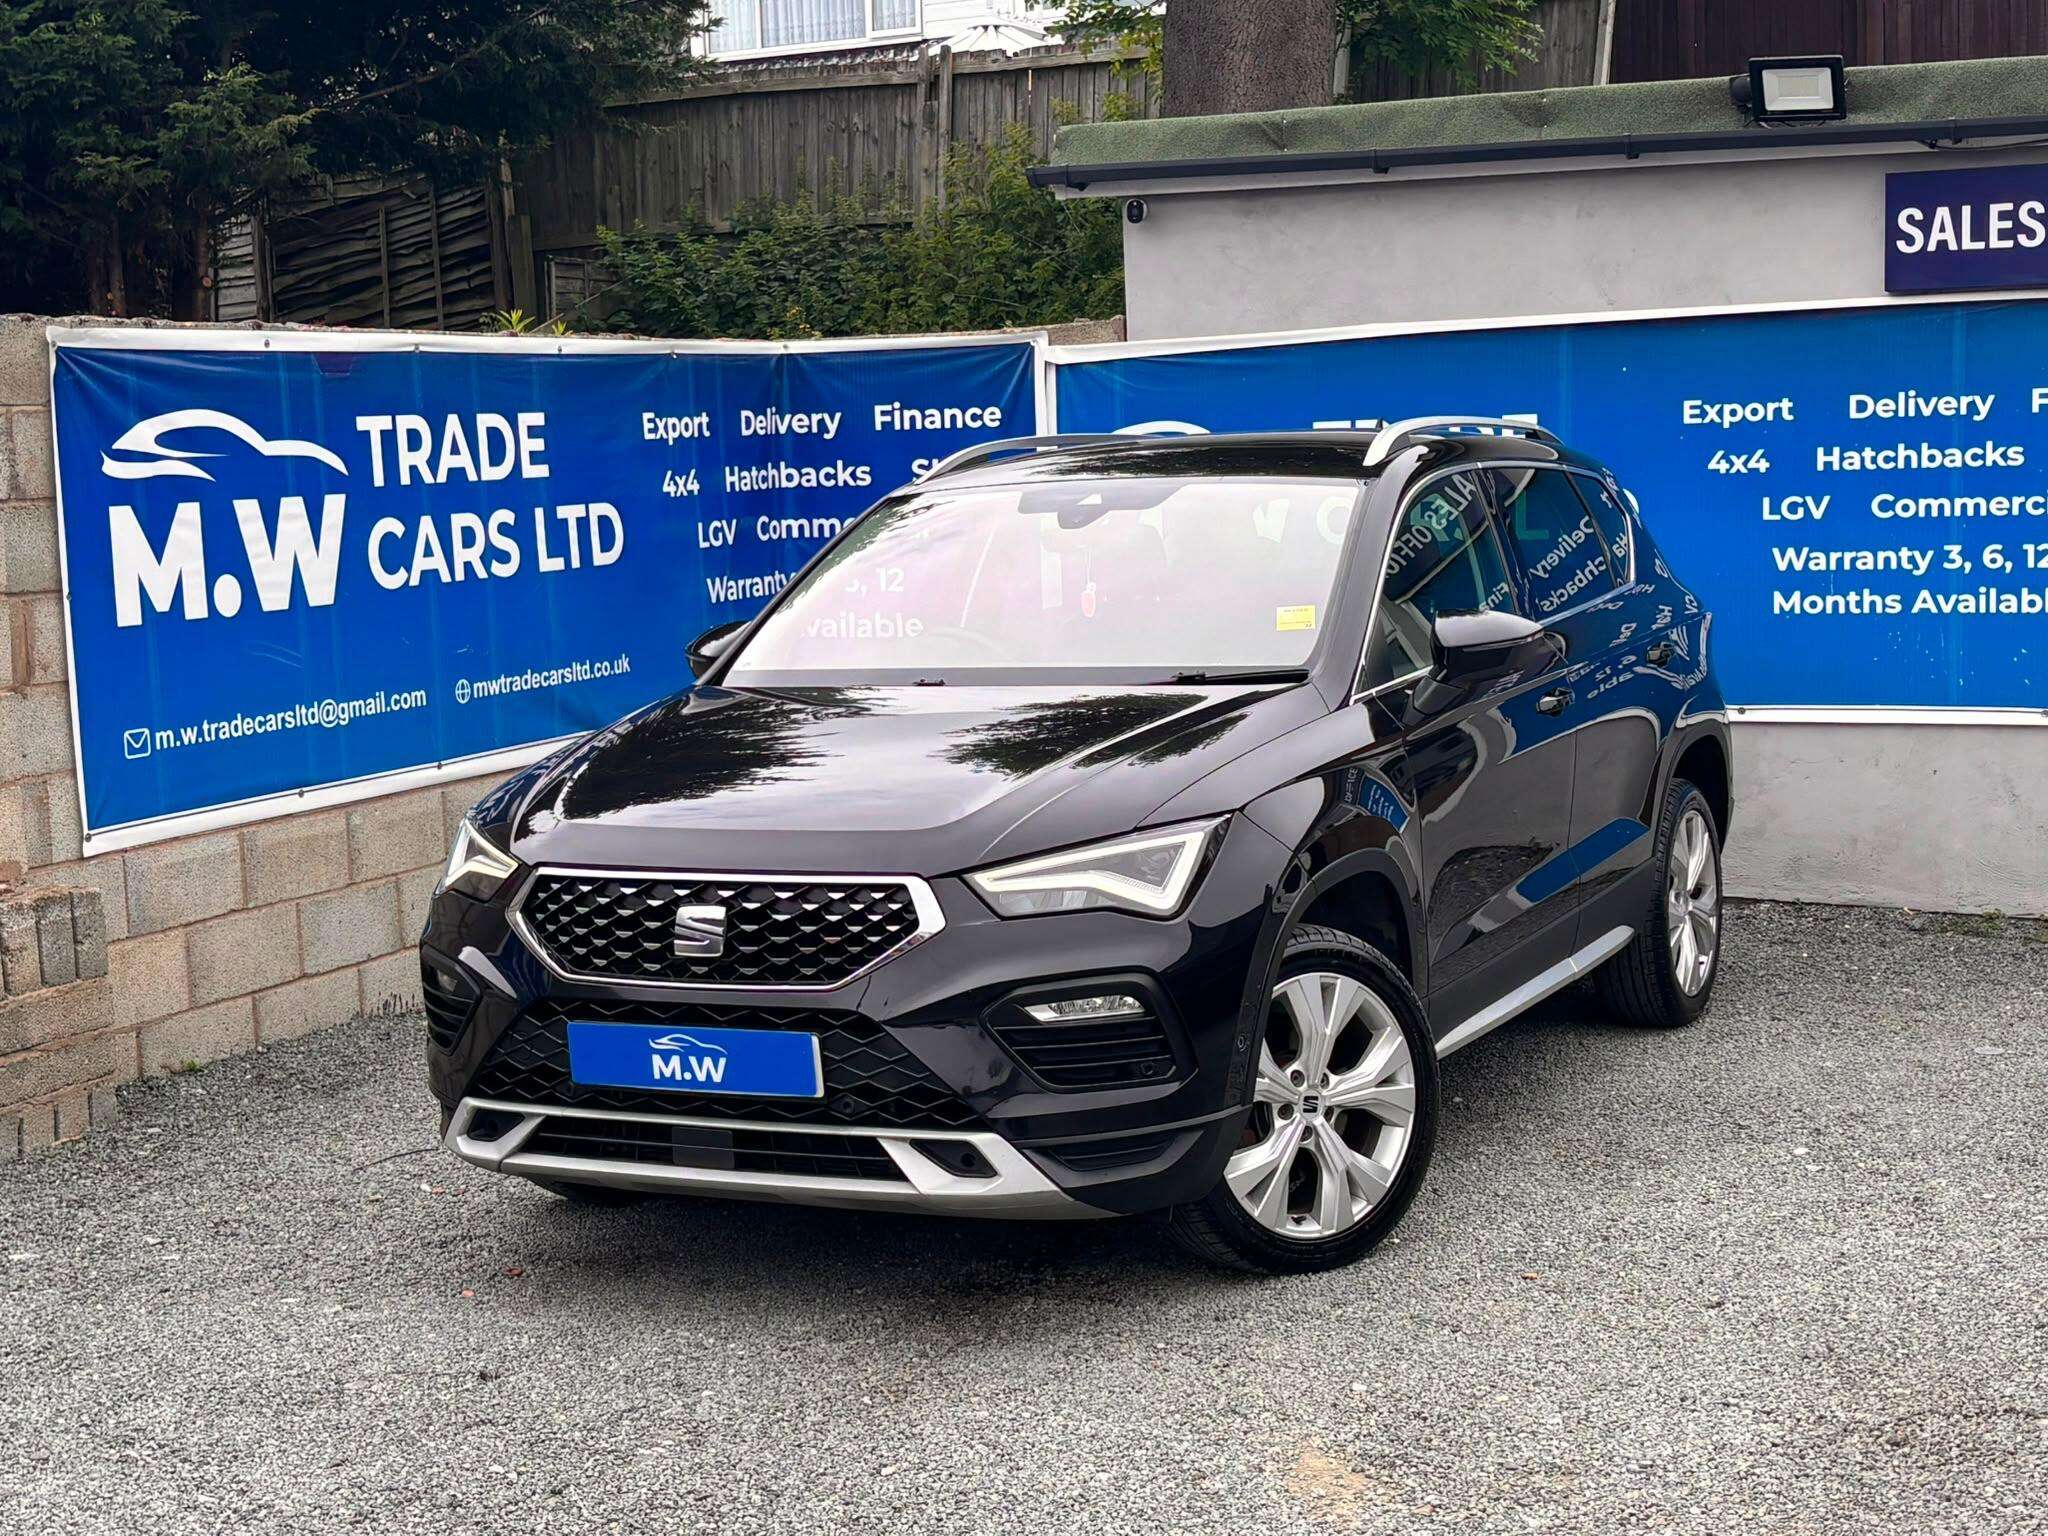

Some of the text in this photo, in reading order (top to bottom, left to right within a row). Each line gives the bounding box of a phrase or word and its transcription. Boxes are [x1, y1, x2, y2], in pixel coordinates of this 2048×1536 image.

[1896, 199, 2047, 254] SALES
[642, 401, 1003, 445] Export Delivery Finance
[1683, 397, 1795, 429] Export
[1849, 390, 1995, 421] Delivery
[356, 411, 549, 488] TRADE
[1707, 441, 2026, 474] 4x4 Hatchbacks
[662, 468, 700, 498] 4x4
[725, 458, 872, 493] Hatchbacks
[1762, 494, 1831, 521] LGV
[367, 502, 624, 590] CARS LTD
[698, 518, 737, 549] LGV
[108, 492, 347, 628] M.W
[1772, 545, 1935, 577] Warranty
[1942, 543, 1973, 574] 3,
[1982, 543, 2014, 574] 6,
[1772, 589, 1902, 615] Months
[473, 653, 632, 699] mwtradecarsltd.co.uk
[155, 686, 427, 752] m.w.tradecarsltd@gmail.com
[651, 1053, 727, 1083] M.W
